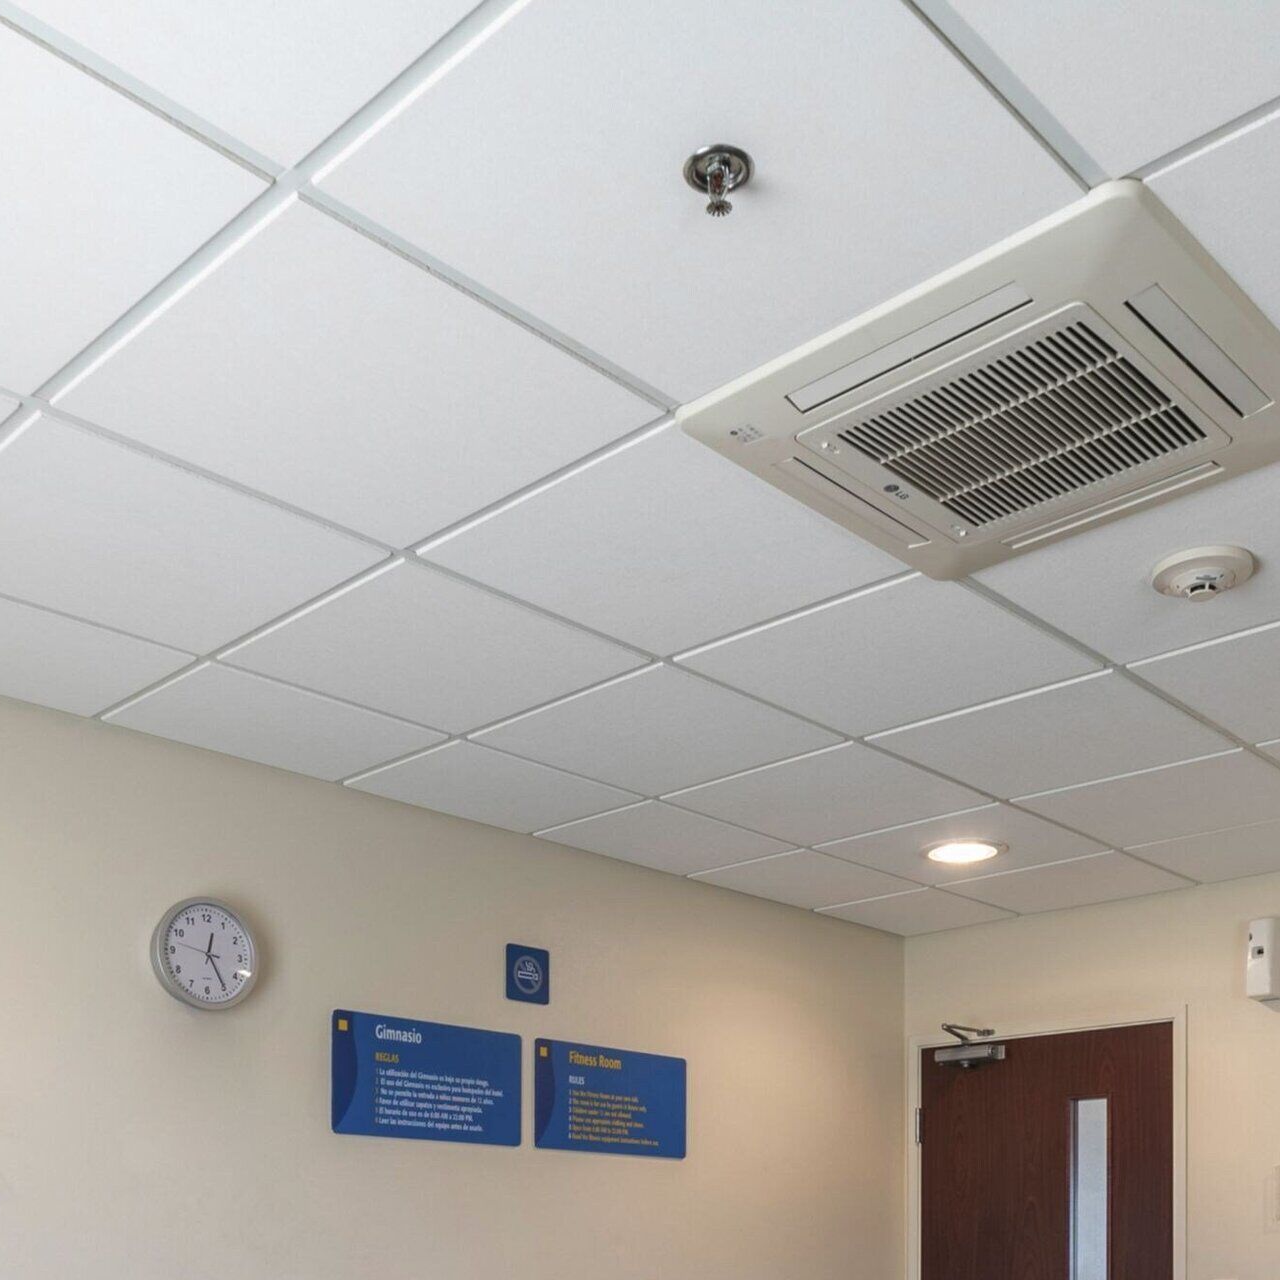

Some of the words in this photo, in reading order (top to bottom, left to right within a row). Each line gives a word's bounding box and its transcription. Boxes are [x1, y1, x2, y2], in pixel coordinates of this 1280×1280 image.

[186, 917, 195, 926] 11
[202, 914, 212, 923] 12
[221, 922, 226, 930] 1
[174, 929, 184, 938] 10
[232, 936, 238, 945] 2
[170, 946, 176, 954] 9
[237, 954, 242, 963] 3
[176, 964, 182, 974] 8
[232, 972, 238, 980] 4
[189, 979, 194, 988] 7
[204, 986, 210, 995] 6
[375, 1023, 422, 1044] Gimnasio
[375, 1052, 400, 1063] REGLAS
[569, 1050, 597, 1067] Fitness
[598, 1054, 622, 1070] Room
